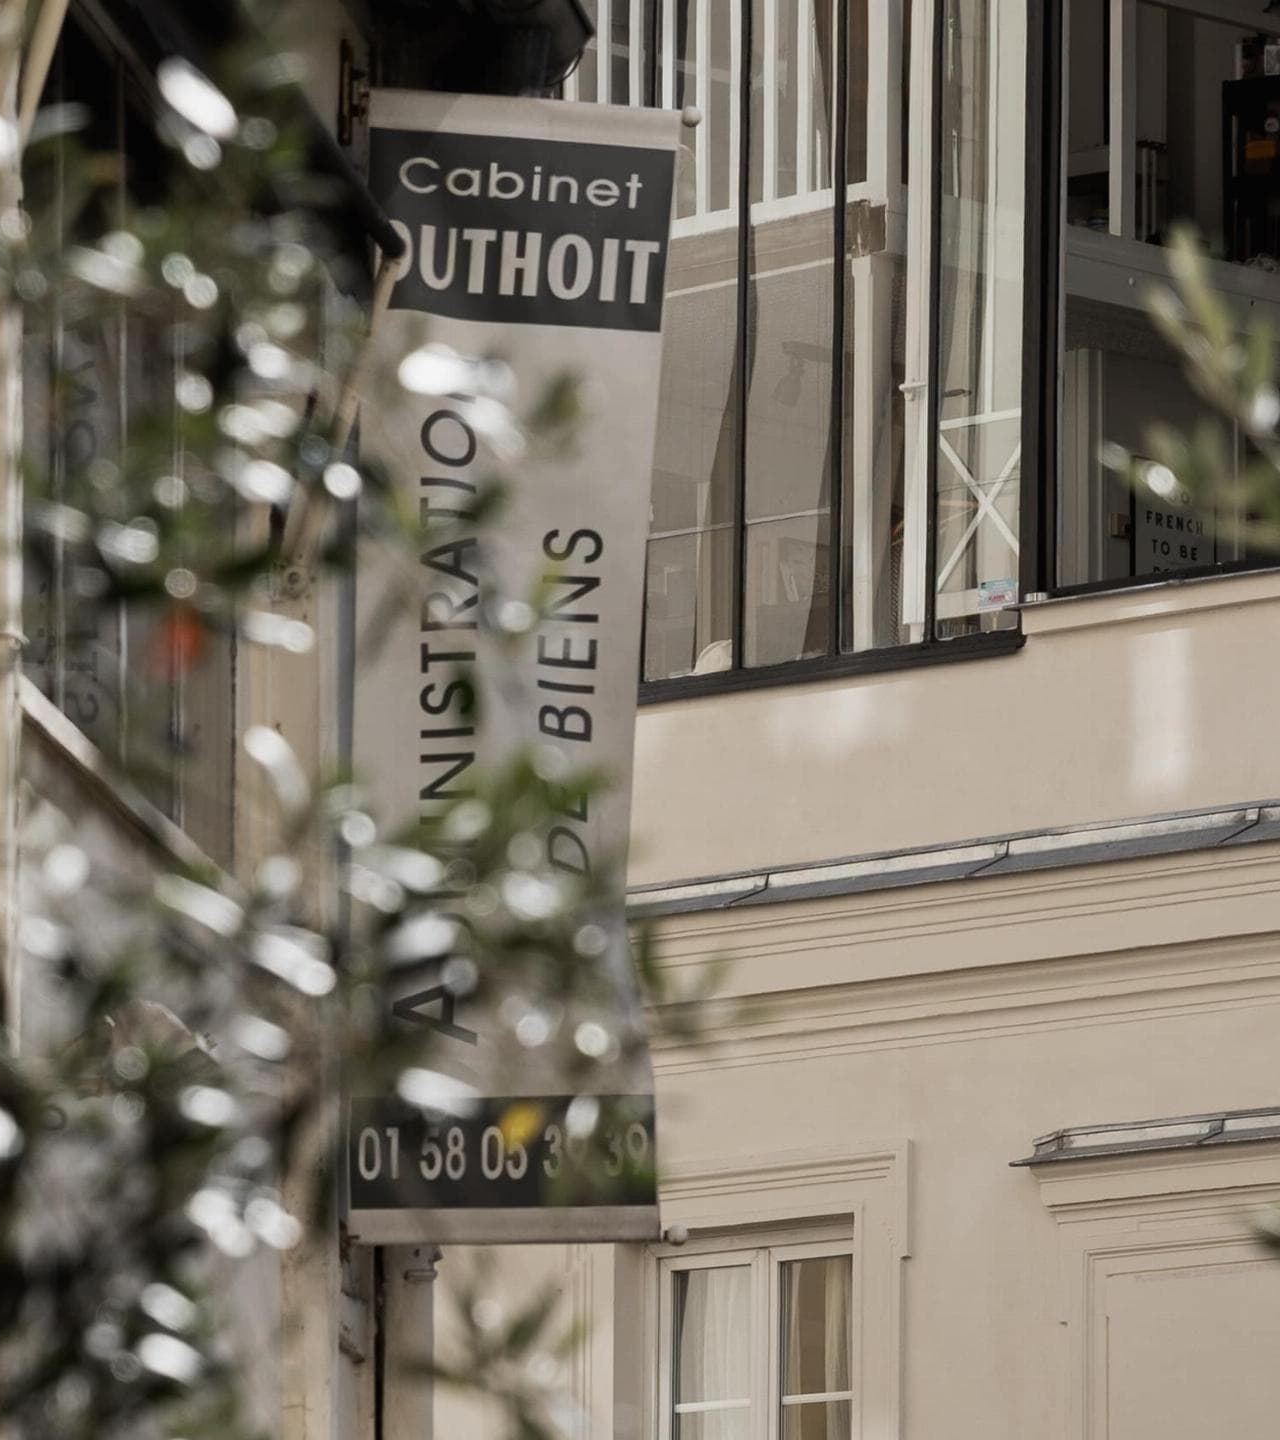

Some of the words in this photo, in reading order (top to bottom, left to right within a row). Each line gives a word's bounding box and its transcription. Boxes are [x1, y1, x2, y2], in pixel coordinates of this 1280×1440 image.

[399, 157, 642, 209] Cabinet
[1146, 510, 1203, 536] FRENCH
[1152, 539, 1170, 556] TO
[1180, 545, 1198, 561] BE
[536, 528, 603, 742] BIENS
[358, 1126, 400, 1181] 01
[419, 1126, 466, 1181] 58
[480, 1125, 528, 1181] 05
